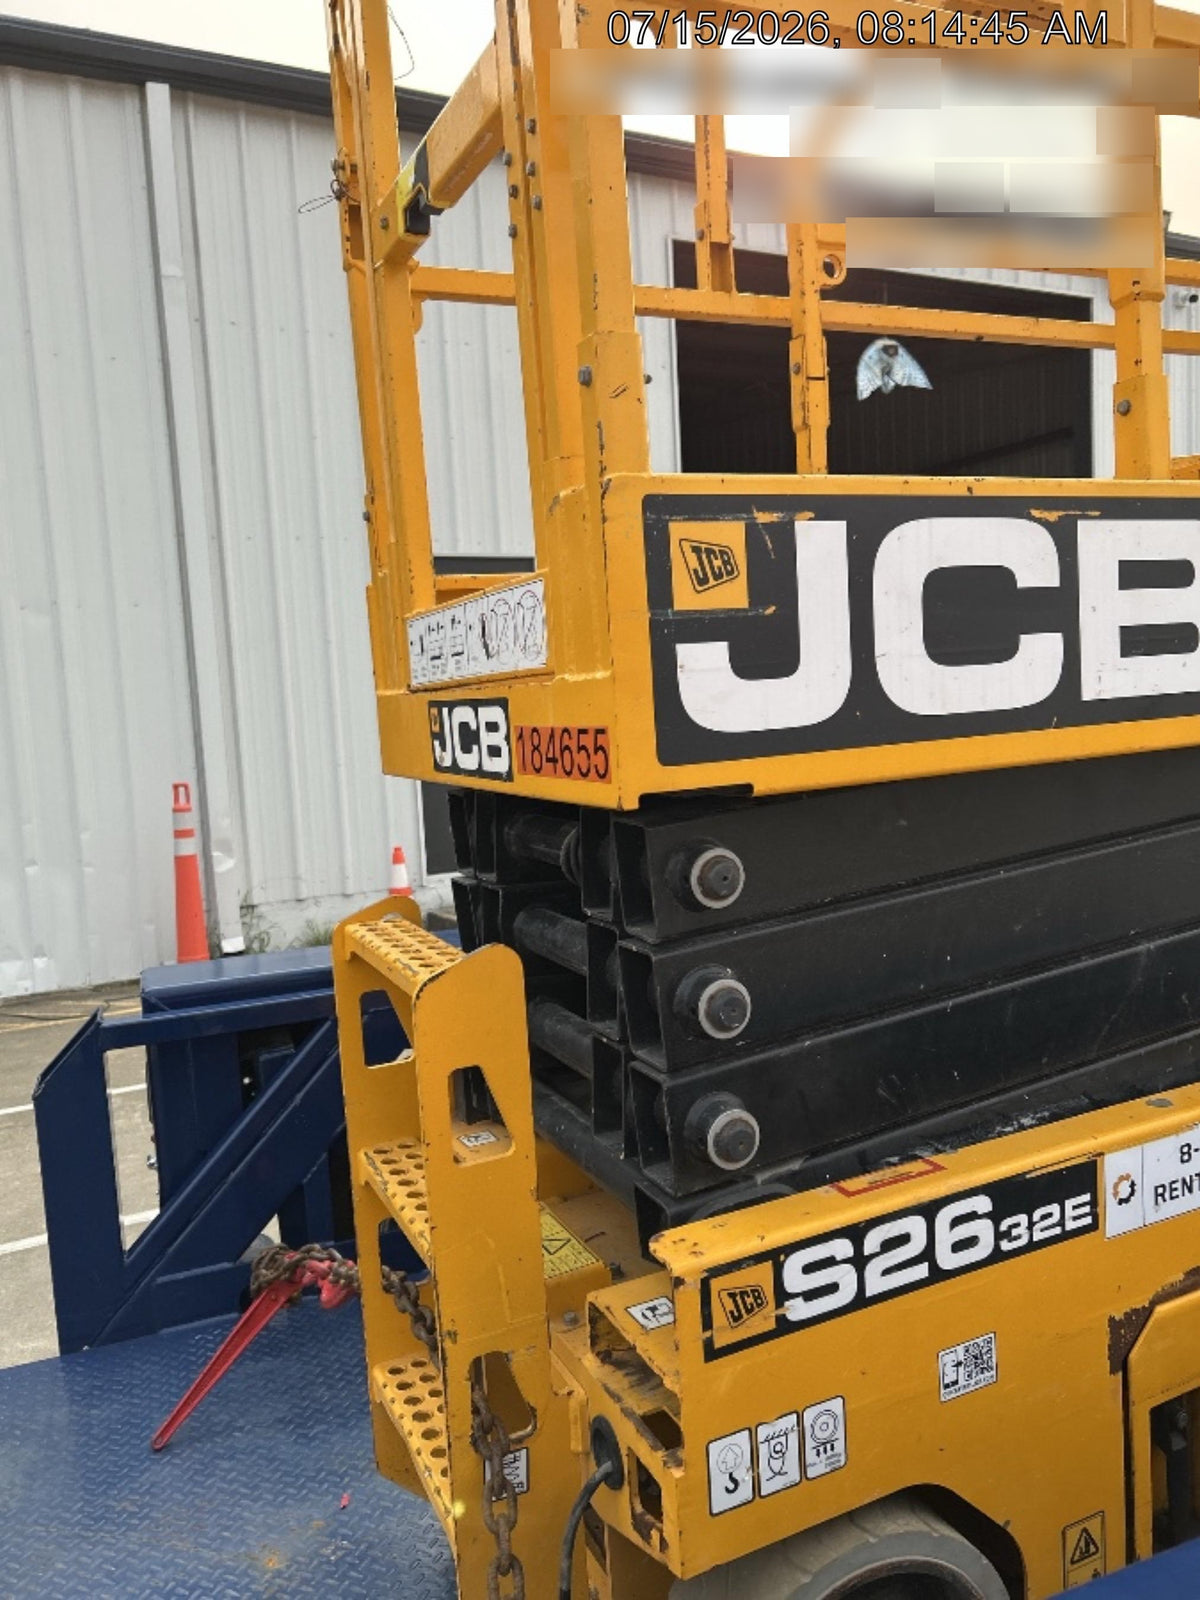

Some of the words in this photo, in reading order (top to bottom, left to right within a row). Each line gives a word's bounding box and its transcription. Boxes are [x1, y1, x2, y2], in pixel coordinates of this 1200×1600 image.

[690, 545, 734, 587] JCB
[676, 517, 1200, 733] JCB
[433, 706, 510, 772] JCB
[517, 726, 609, 779] 184655
[727, 1289, 765, 1322] JCB
